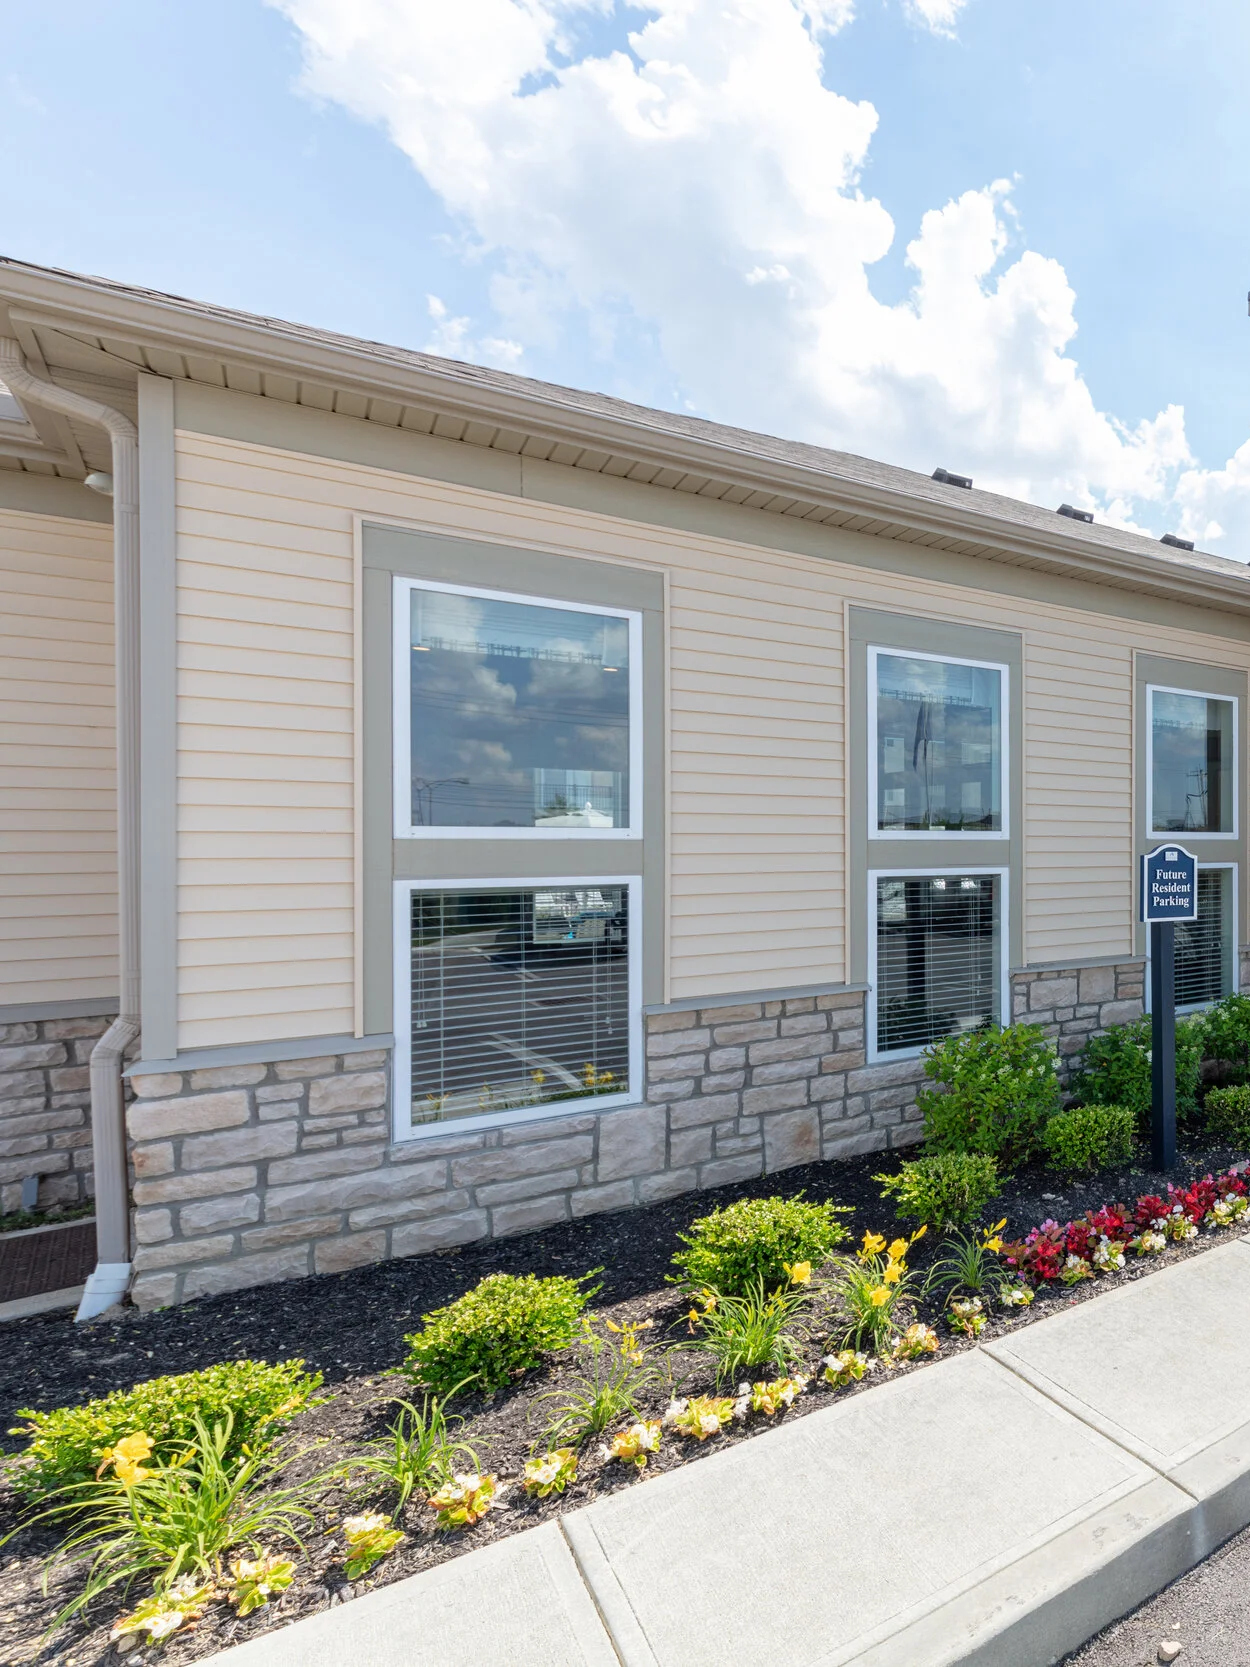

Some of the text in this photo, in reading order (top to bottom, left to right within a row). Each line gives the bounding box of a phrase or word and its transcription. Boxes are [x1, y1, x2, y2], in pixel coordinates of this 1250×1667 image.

[1156, 869, 1187, 879] Future
[1152, 882, 1191, 893] Resident
[1153, 895, 1189, 908] Parking
